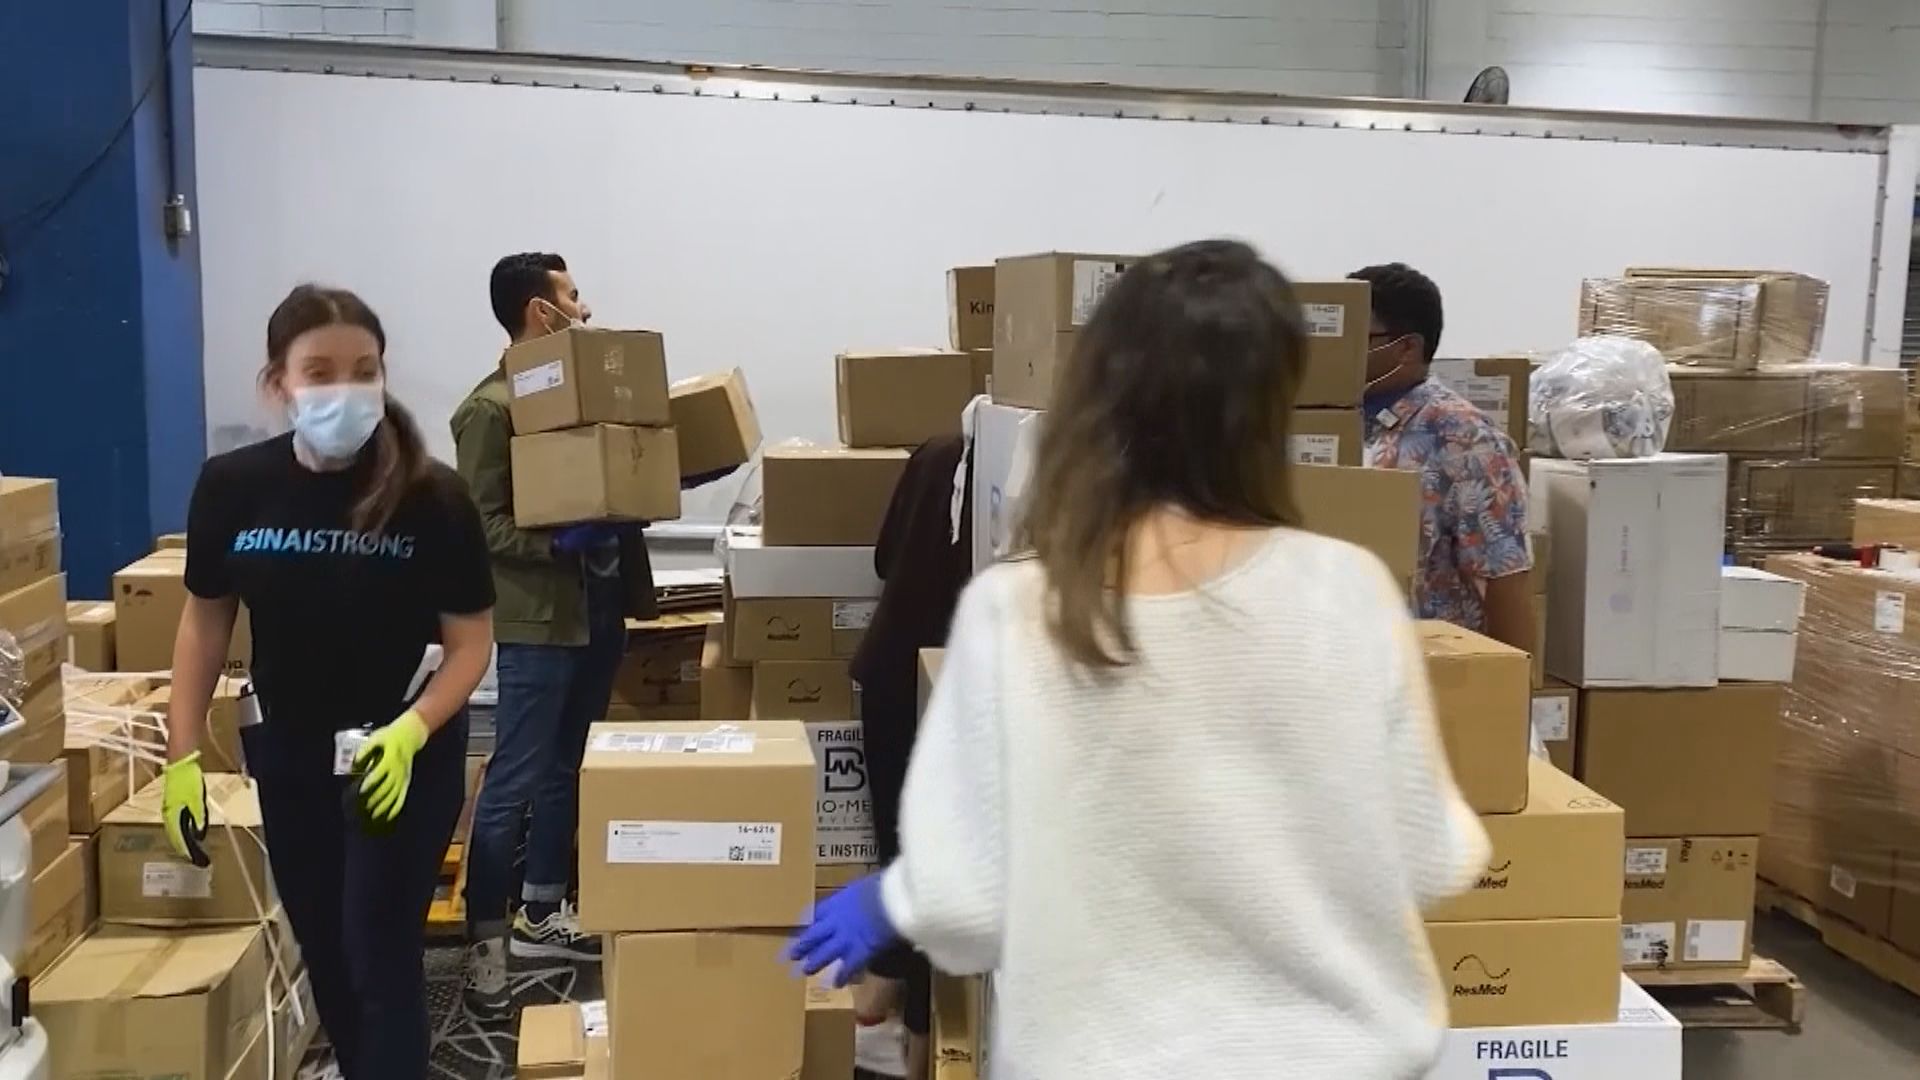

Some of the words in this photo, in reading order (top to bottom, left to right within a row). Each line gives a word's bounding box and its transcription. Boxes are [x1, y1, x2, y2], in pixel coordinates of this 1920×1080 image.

[970, 301, 994, 314] Kin
[234, 527, 416, 559] #SINAISTRONG
[1453, 984, 1507, 996] ResMed
[1477, 1040, 1568, 1059] FRAGILE
